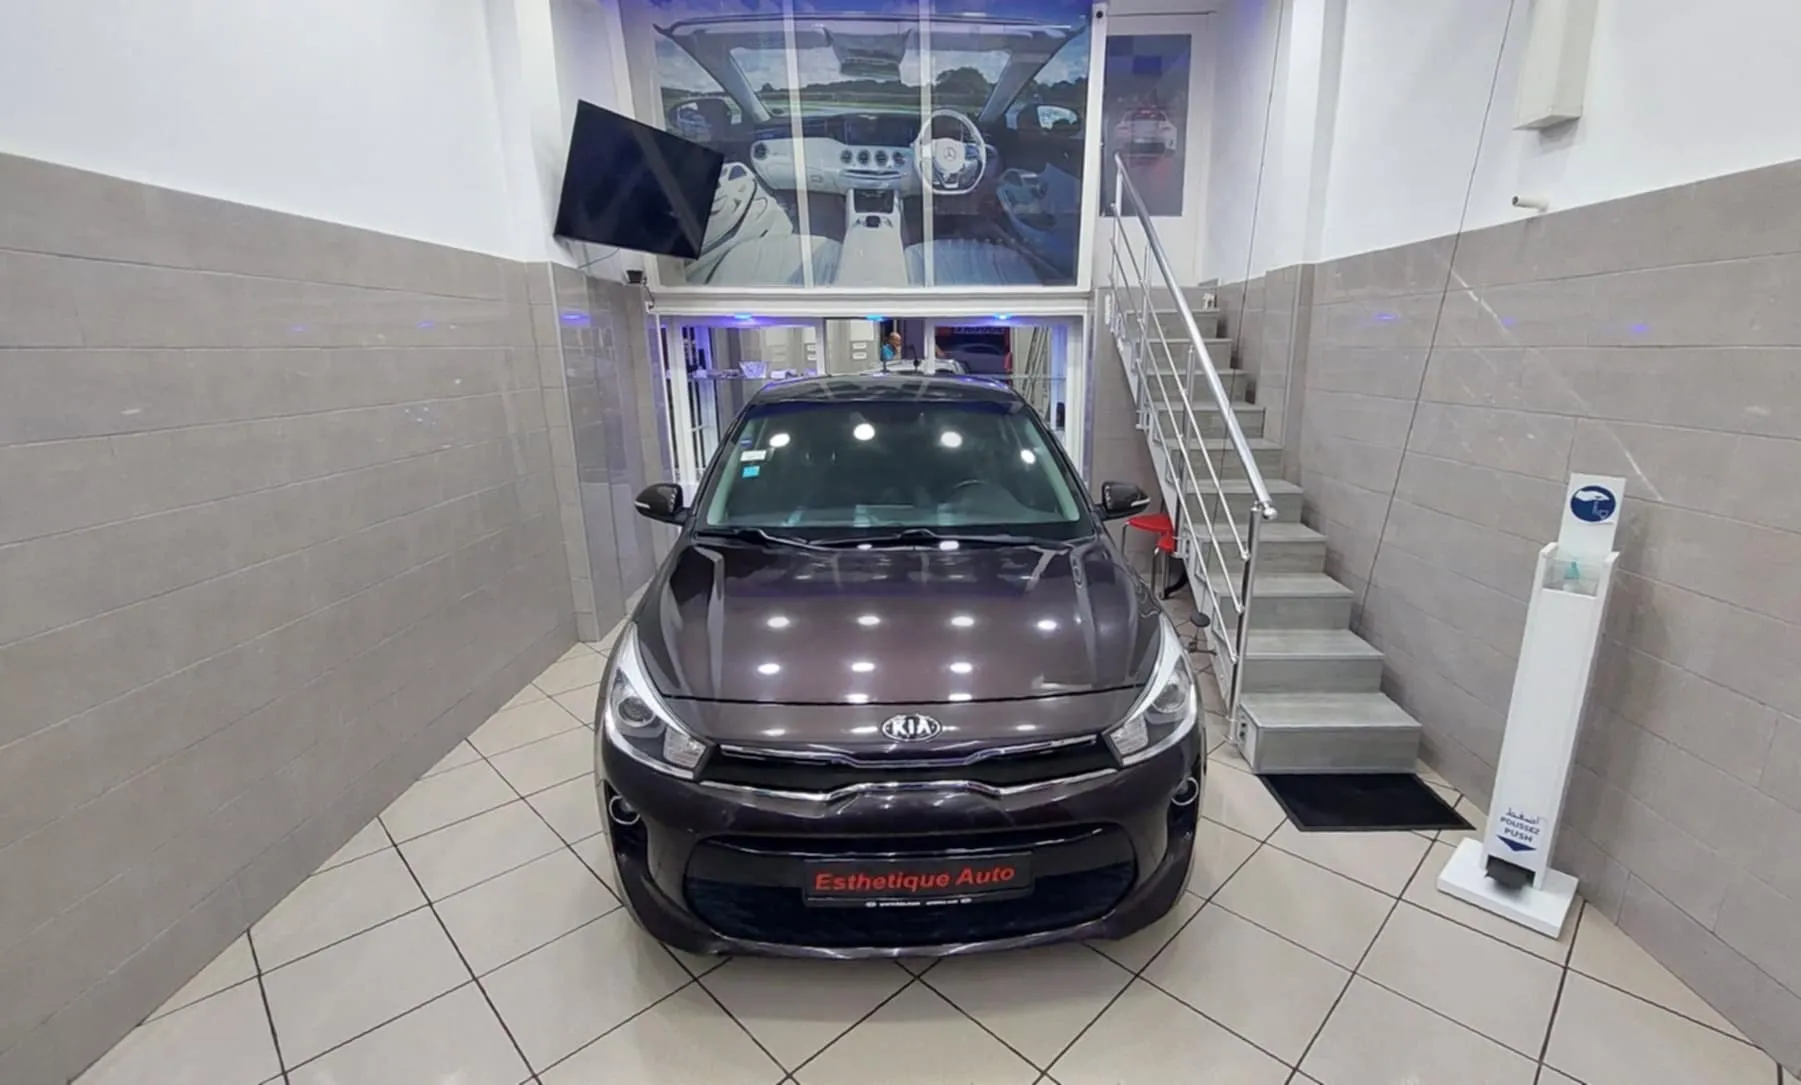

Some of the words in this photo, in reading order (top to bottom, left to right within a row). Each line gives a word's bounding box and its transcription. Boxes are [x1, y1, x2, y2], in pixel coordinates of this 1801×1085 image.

[892, 715, 931, 736] KIA
[1504, 827, 1533, 842] PUSH
[815, 871, 949, 892] Esthetique
[956, 866, 1015, 885] Auto
